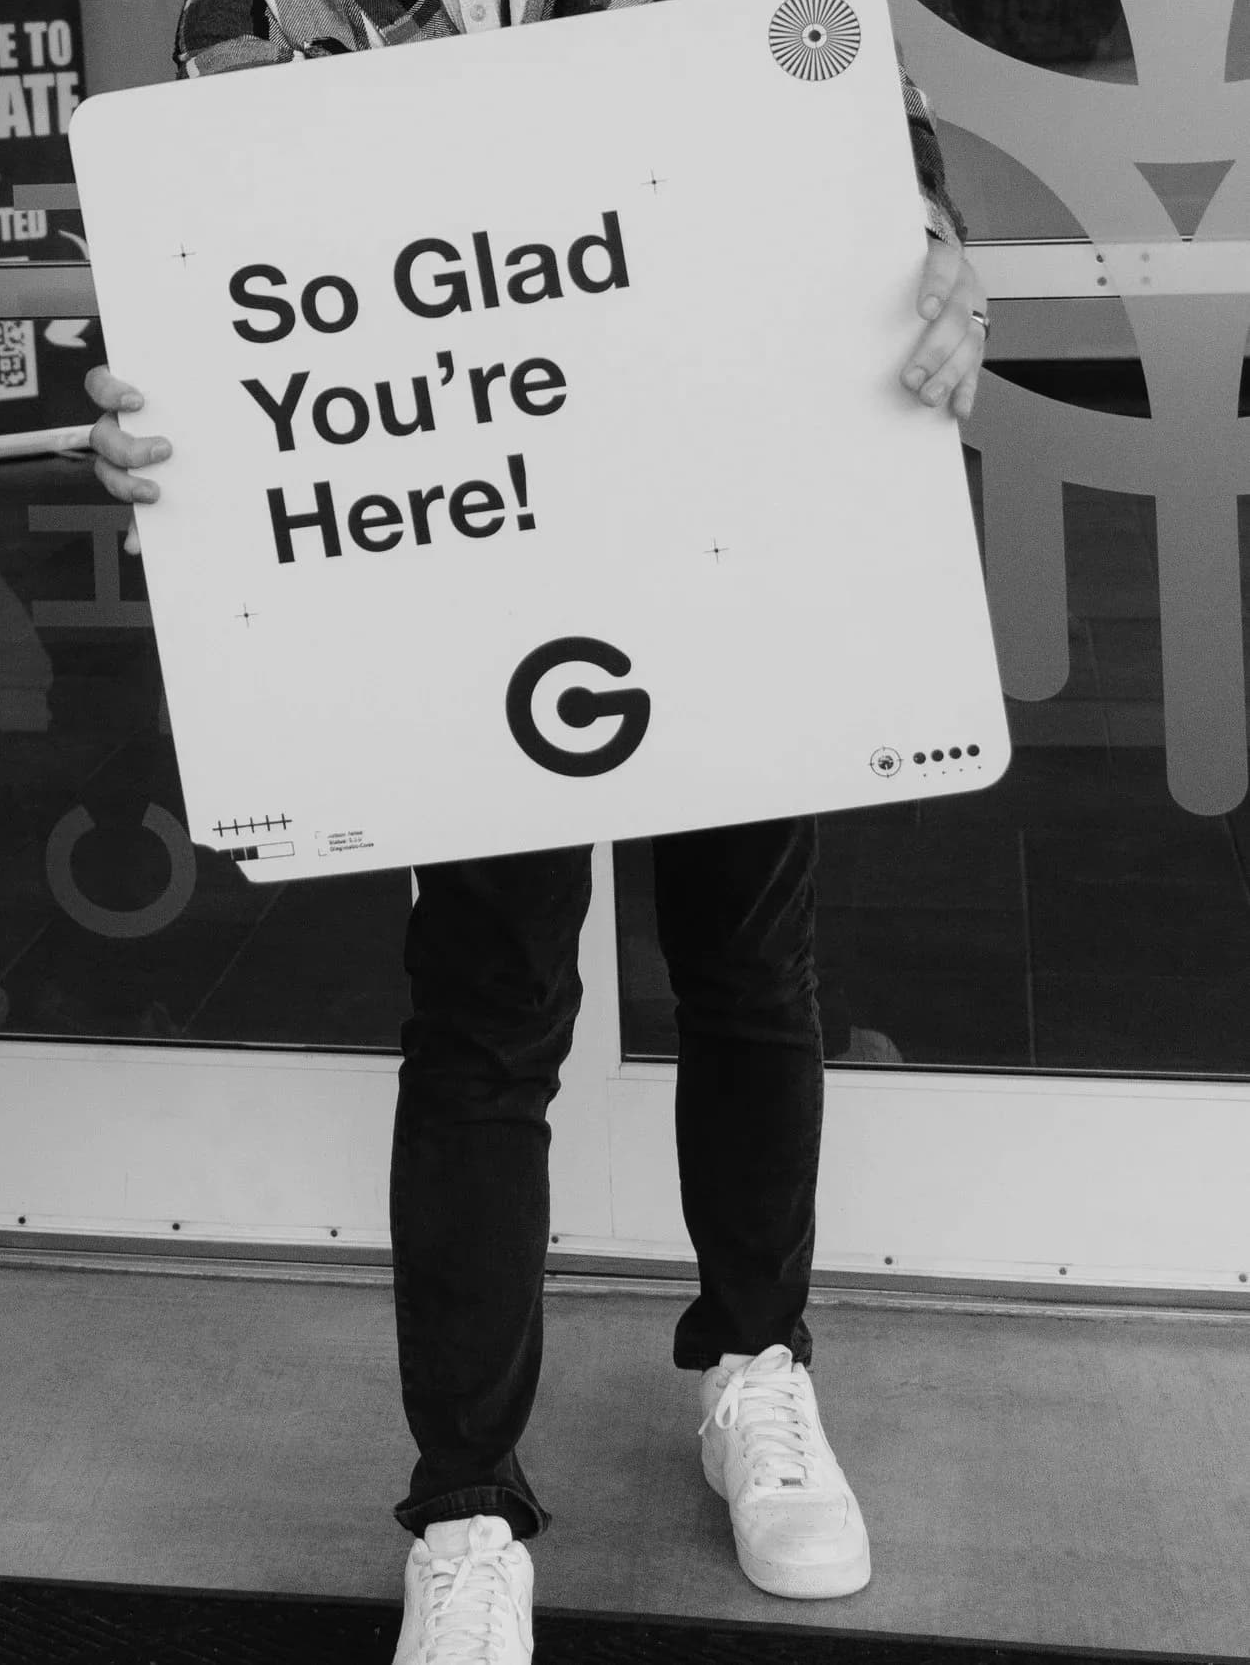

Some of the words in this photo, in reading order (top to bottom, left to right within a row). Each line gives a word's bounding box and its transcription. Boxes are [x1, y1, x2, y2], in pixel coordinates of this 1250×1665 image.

[22, 19, 74, 68] TO
[228, 263, 360, 345] So
[392, 209, 631, 320] Glad
[239, 349, 568, 453] You’re
[266, 452, 538, 565] Here!
